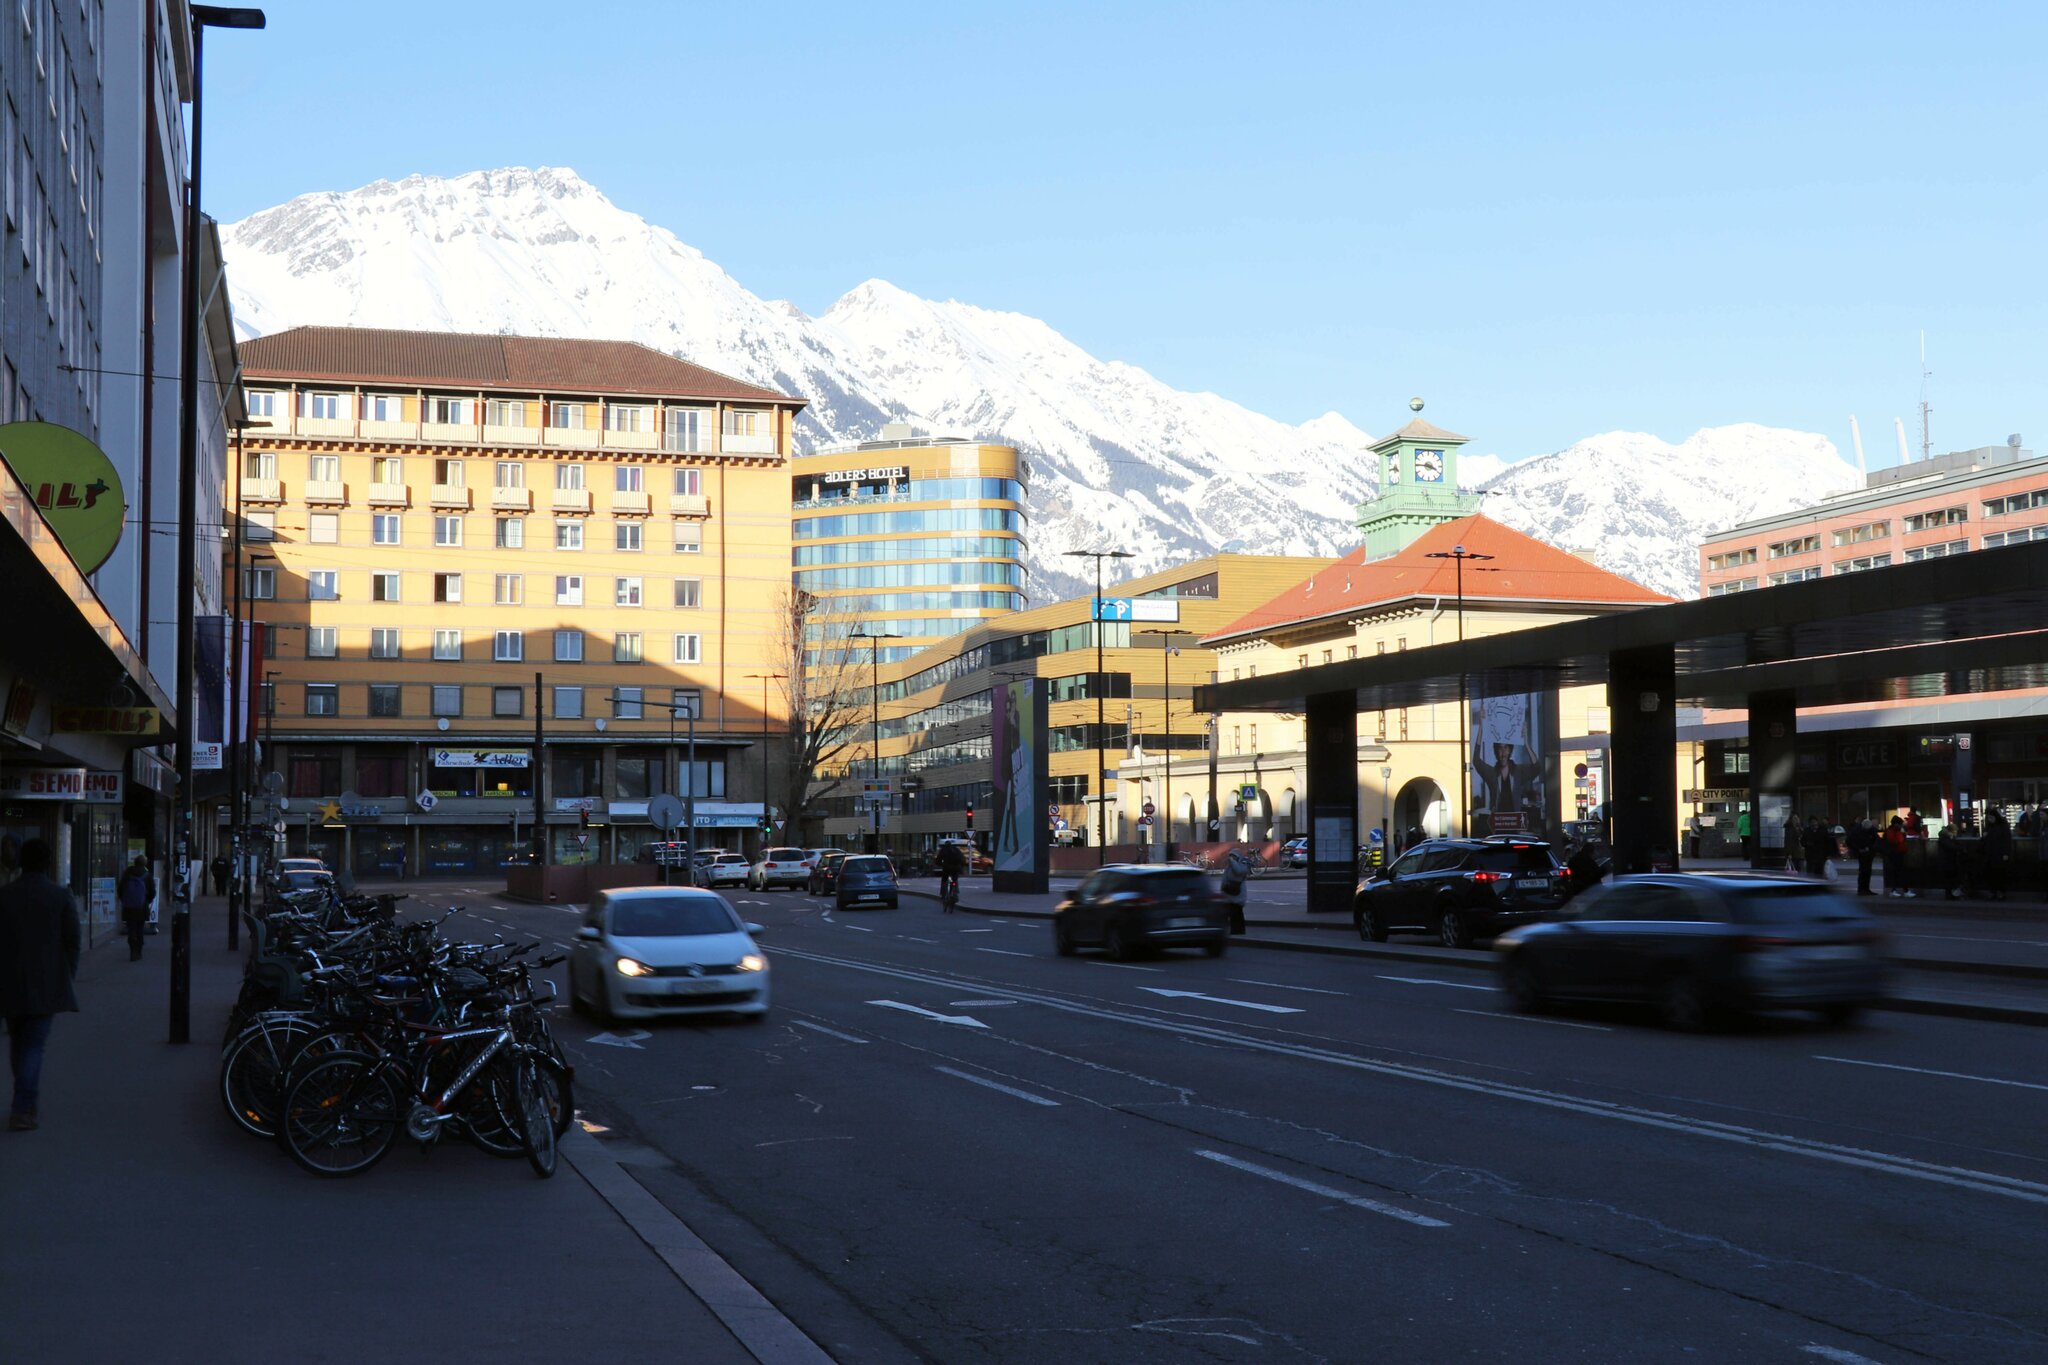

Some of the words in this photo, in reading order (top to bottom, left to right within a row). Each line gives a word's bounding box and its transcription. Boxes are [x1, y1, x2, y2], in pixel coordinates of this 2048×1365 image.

[868, 467, 906, 479] HOTEL
[0, 774, 21, 791] afe
[30, 773, 81, 793] SEMO
[84, 774, 117, 791] EMO
[1703, 789, 1719, 799] CITY
[1720, 789, 1745, 799] POINT
